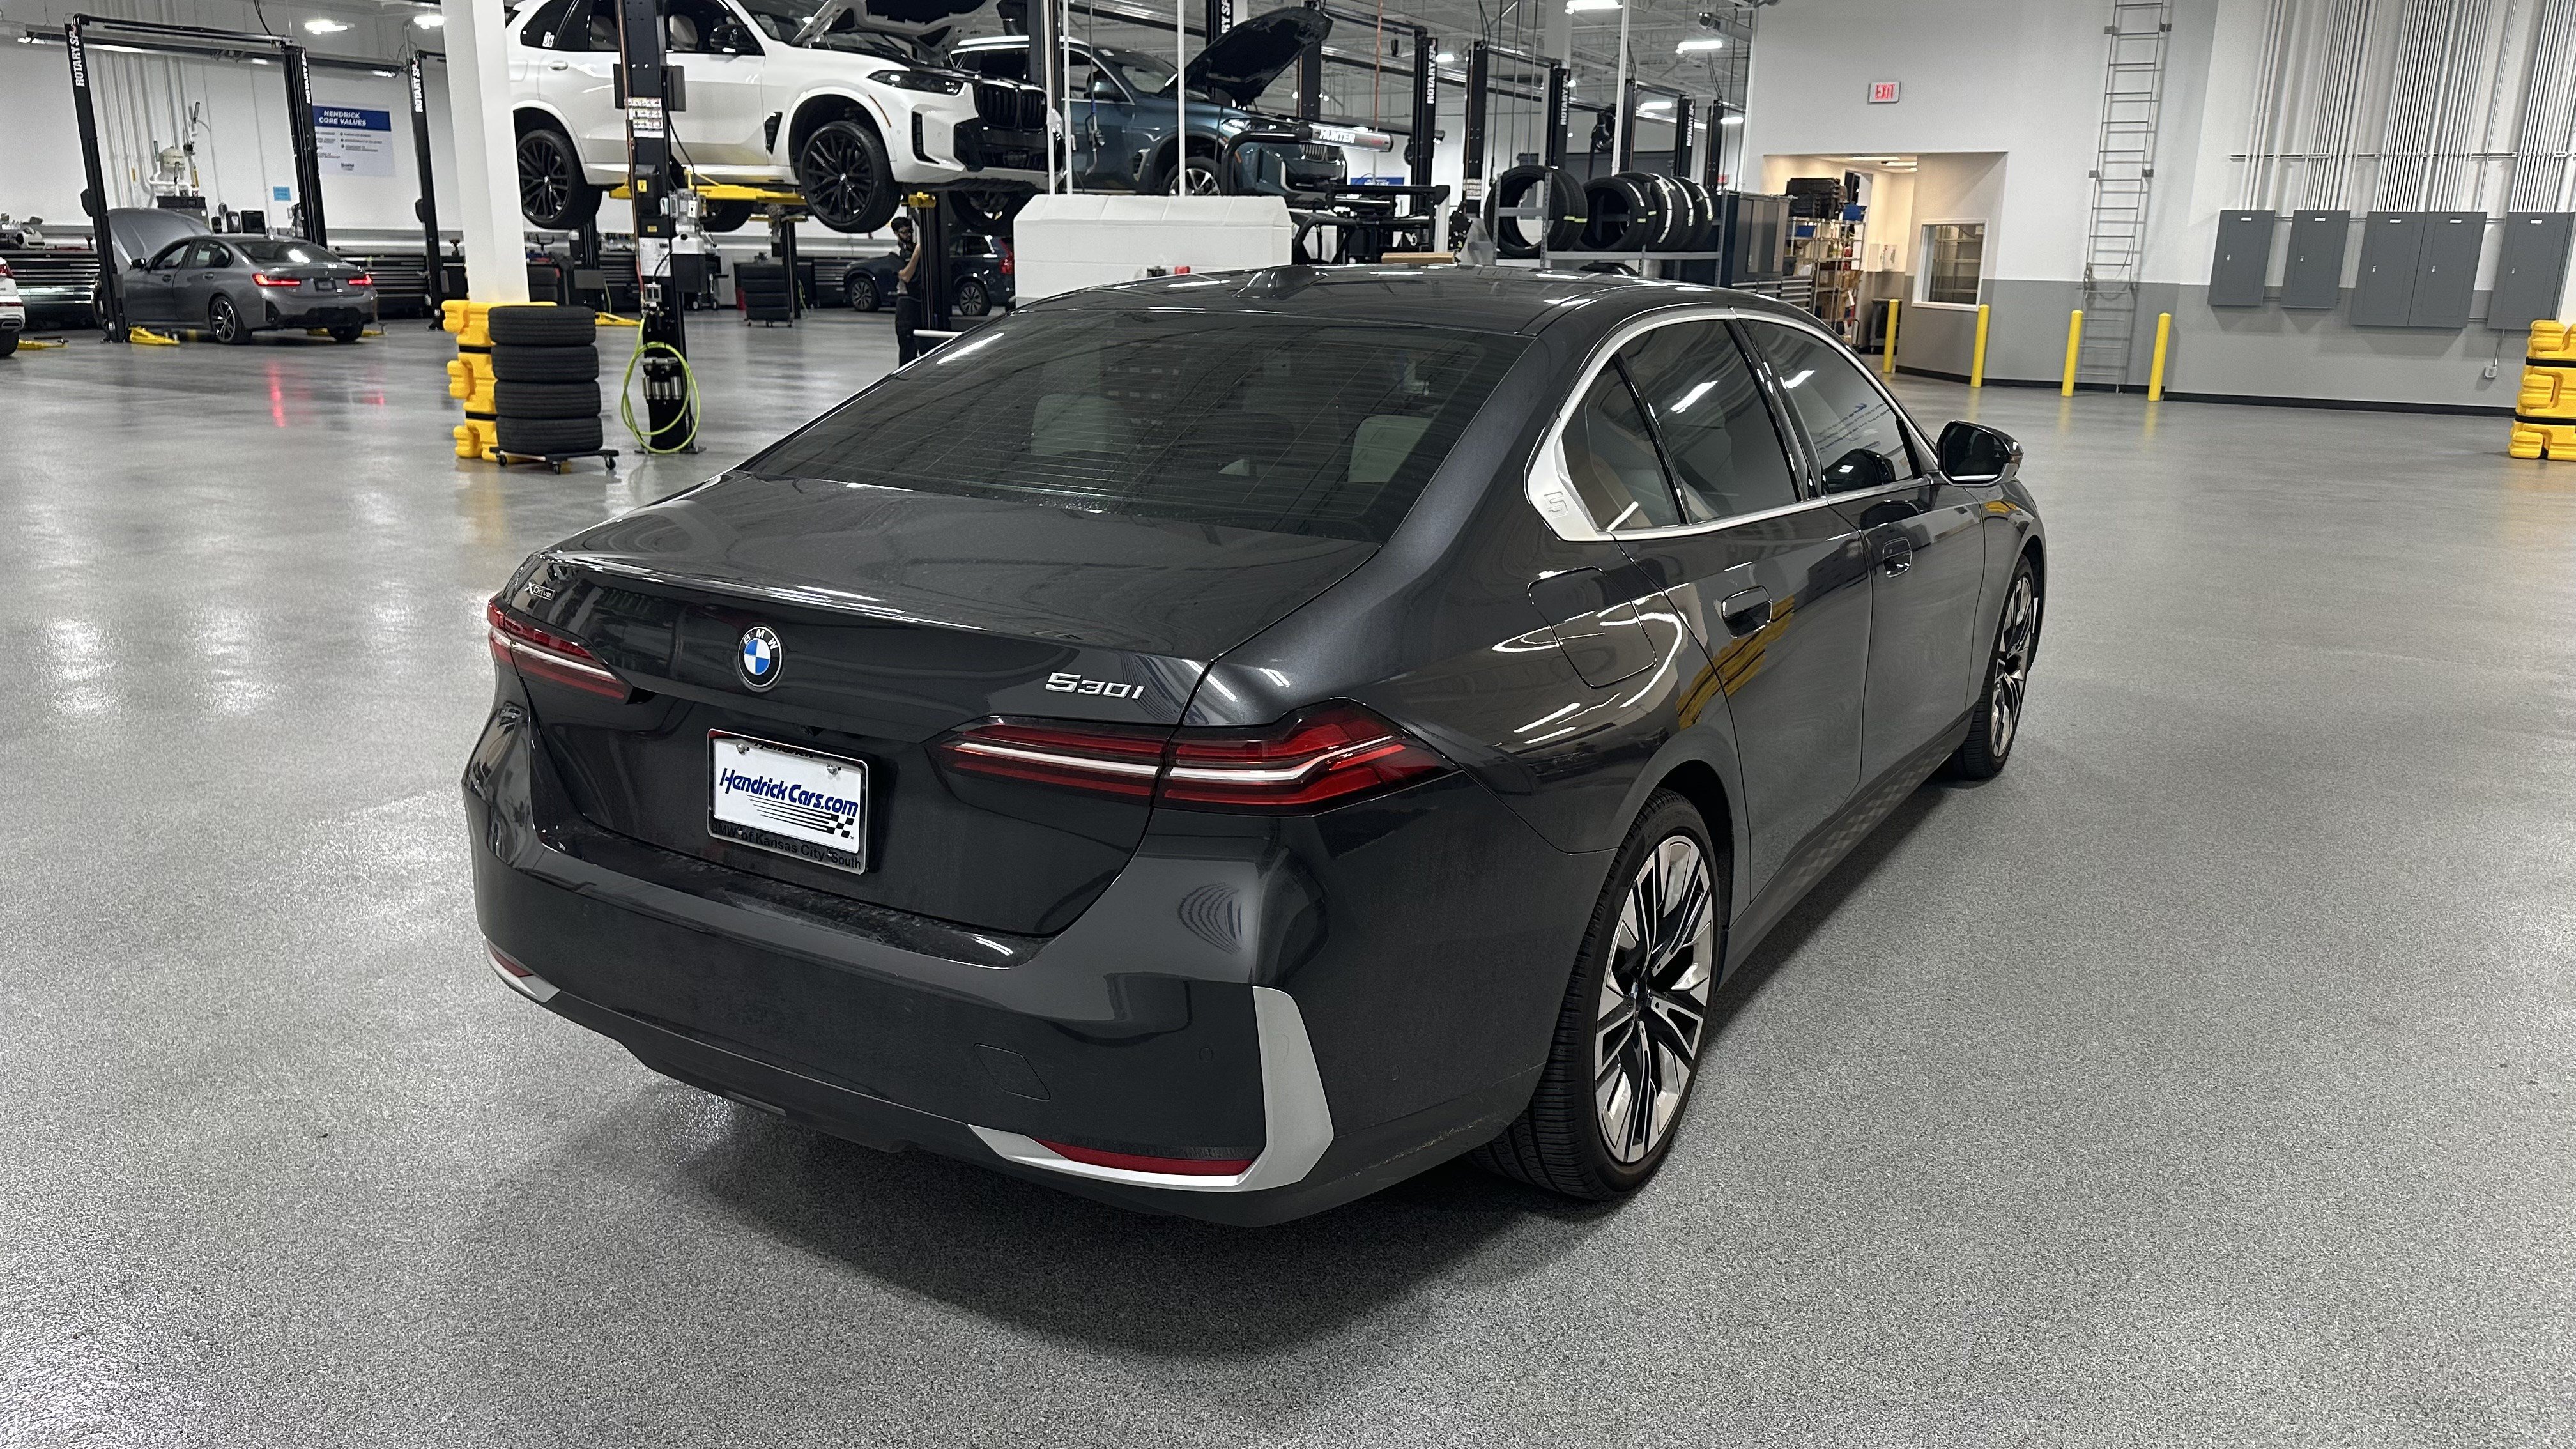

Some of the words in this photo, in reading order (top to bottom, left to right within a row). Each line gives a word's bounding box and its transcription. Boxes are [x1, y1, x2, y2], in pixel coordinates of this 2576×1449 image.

[71, 46, 85, 87] ROTARY
[413, 77, 423, 112] ROTARY
[1427, 61, 1436, 104] ROTARY
[1875, 84, 1896, 99] EXIT
[319, 116, 338, 125] CORE
[340, 118, 367, 126] VALUES
[324, 110, 360, 119] HENDRICK
[1560, 89, 1568, 125] ROTARY
[1319, 129, 1355, 144] HUNTER
[743, 628, 778, 650] BMW
[1045, 672, 1146, 700] 530i
[742, 831, 753, 842] of
[756, 832, 797, 853] Kansas
[801, 844, 825, 862] City
[831, 852, 861, 870] South
